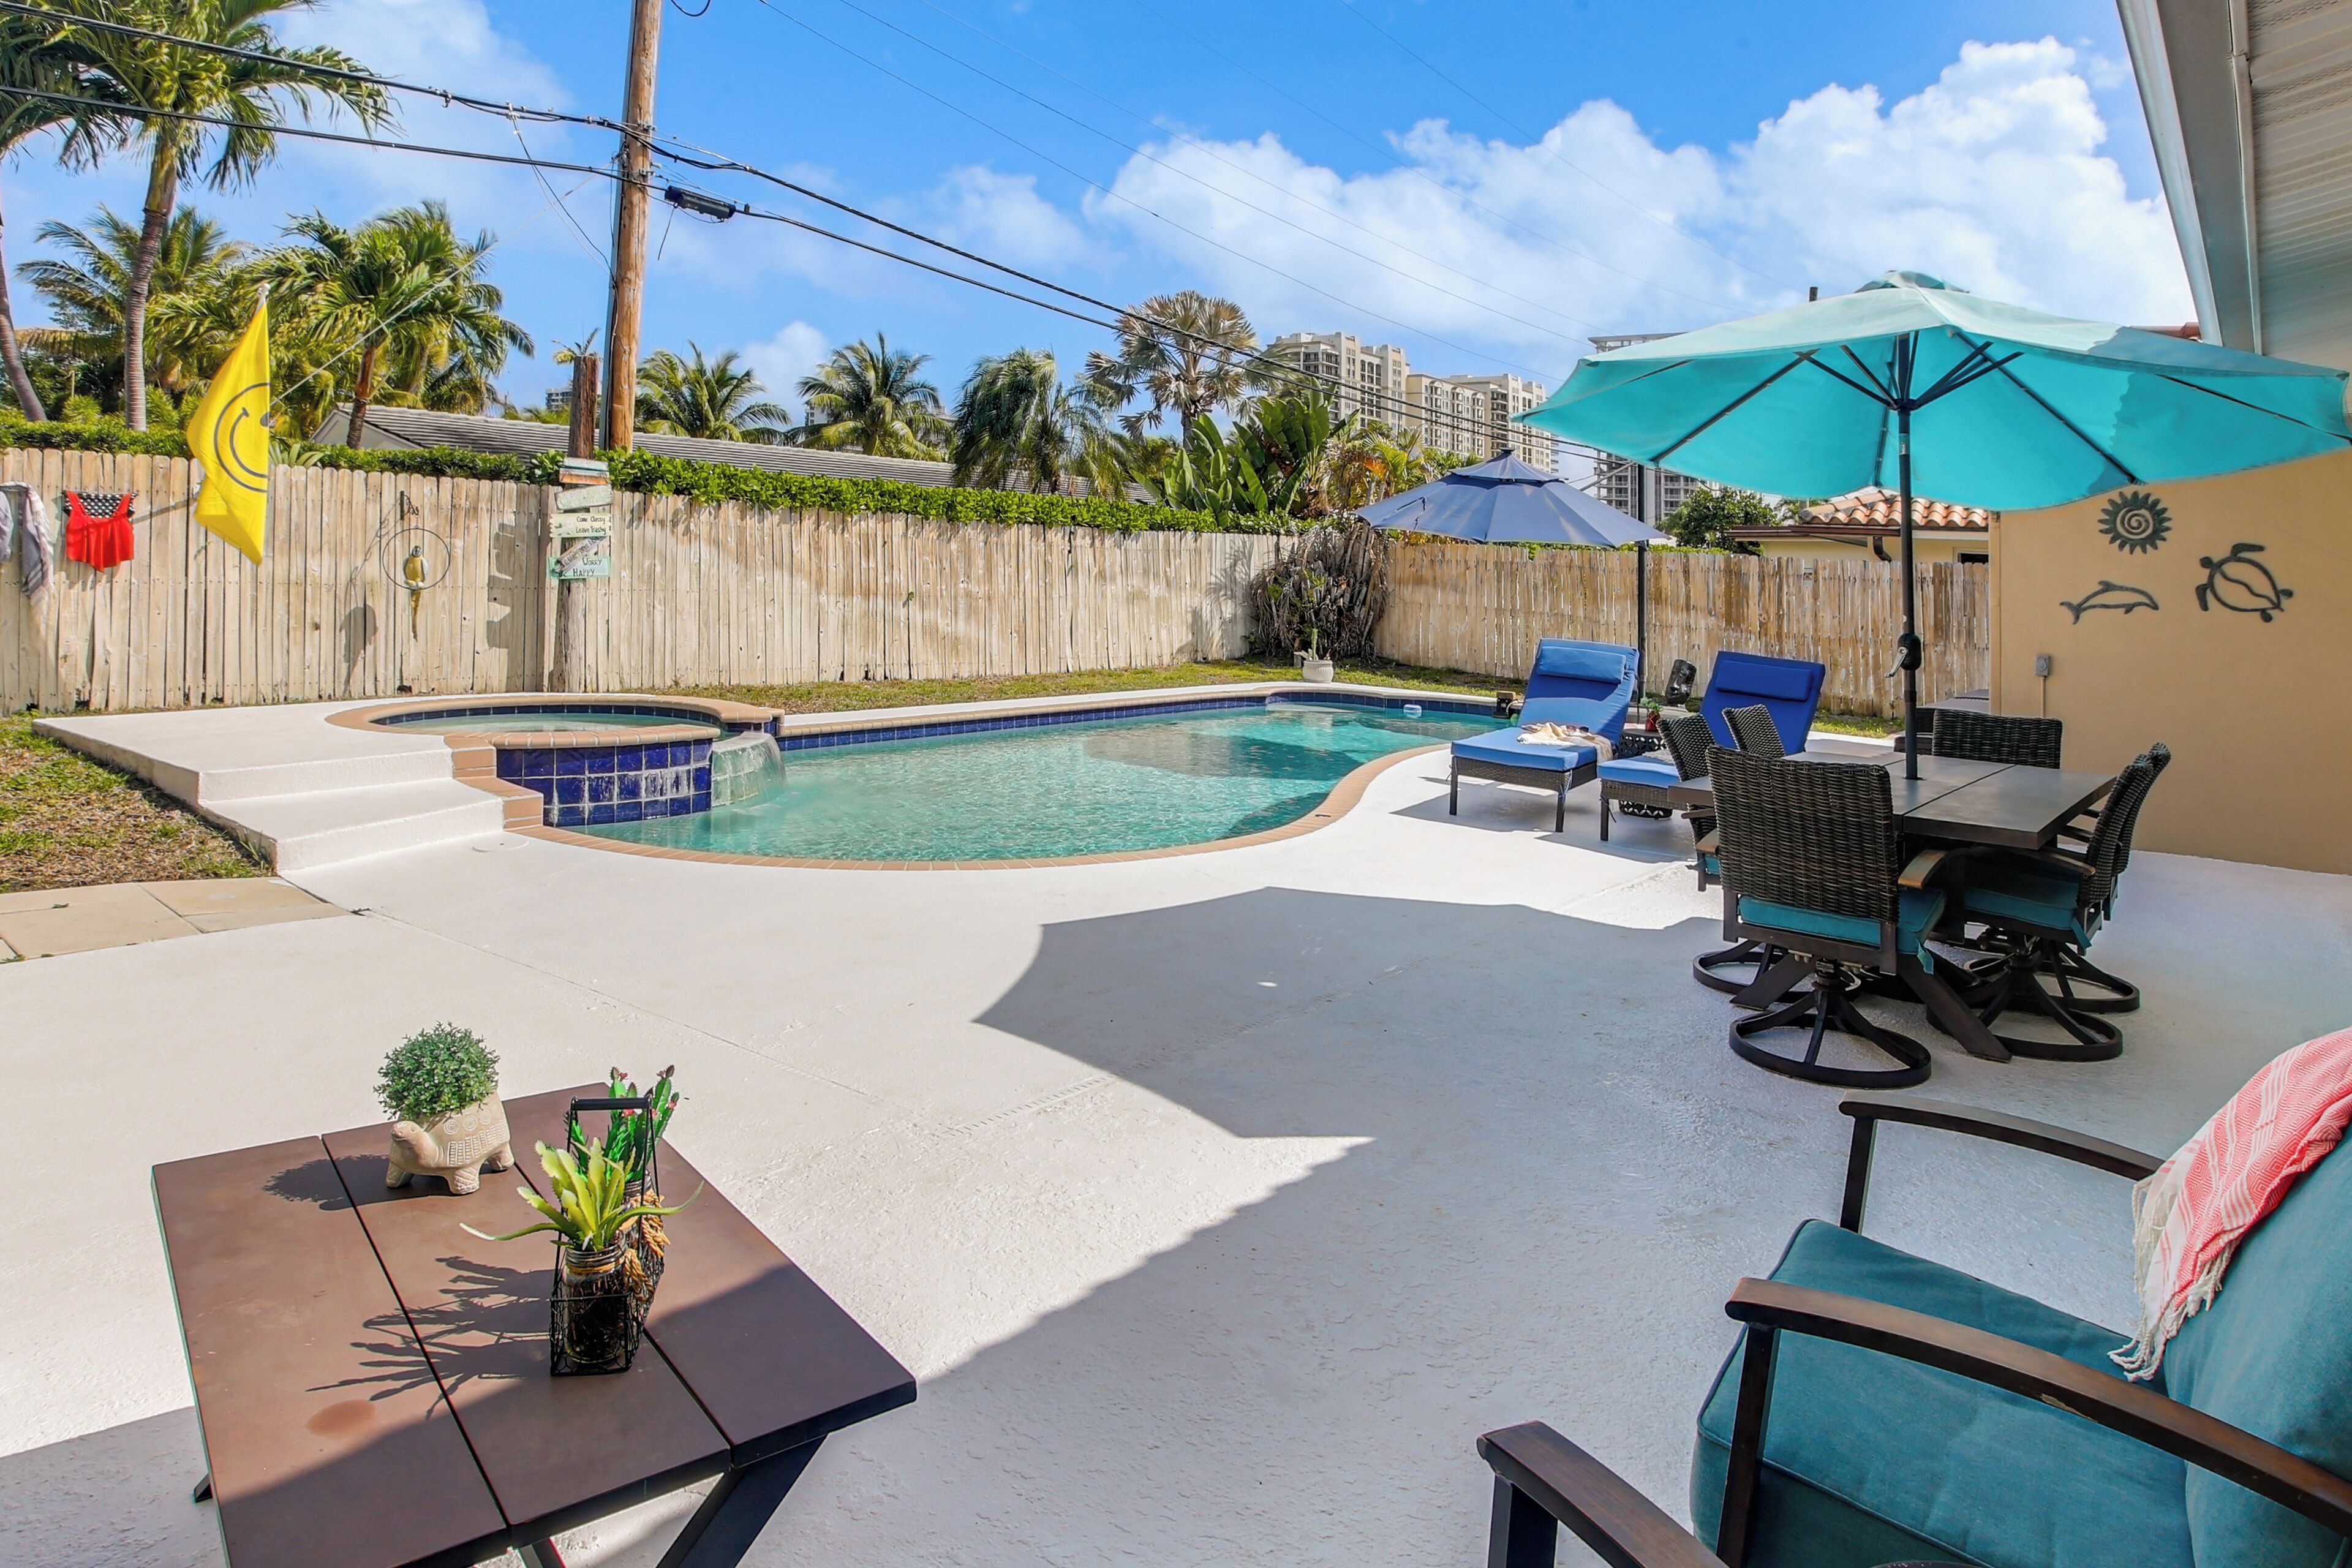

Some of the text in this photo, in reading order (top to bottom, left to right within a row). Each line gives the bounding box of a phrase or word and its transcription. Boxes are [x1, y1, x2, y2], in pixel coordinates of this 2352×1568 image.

[590, 516, 605, 524] Classy
[590, 526, 606, 535] Trashy
[582, 557, 602, 566] WORRY
[573, 568, 595, 577] HAPPY
